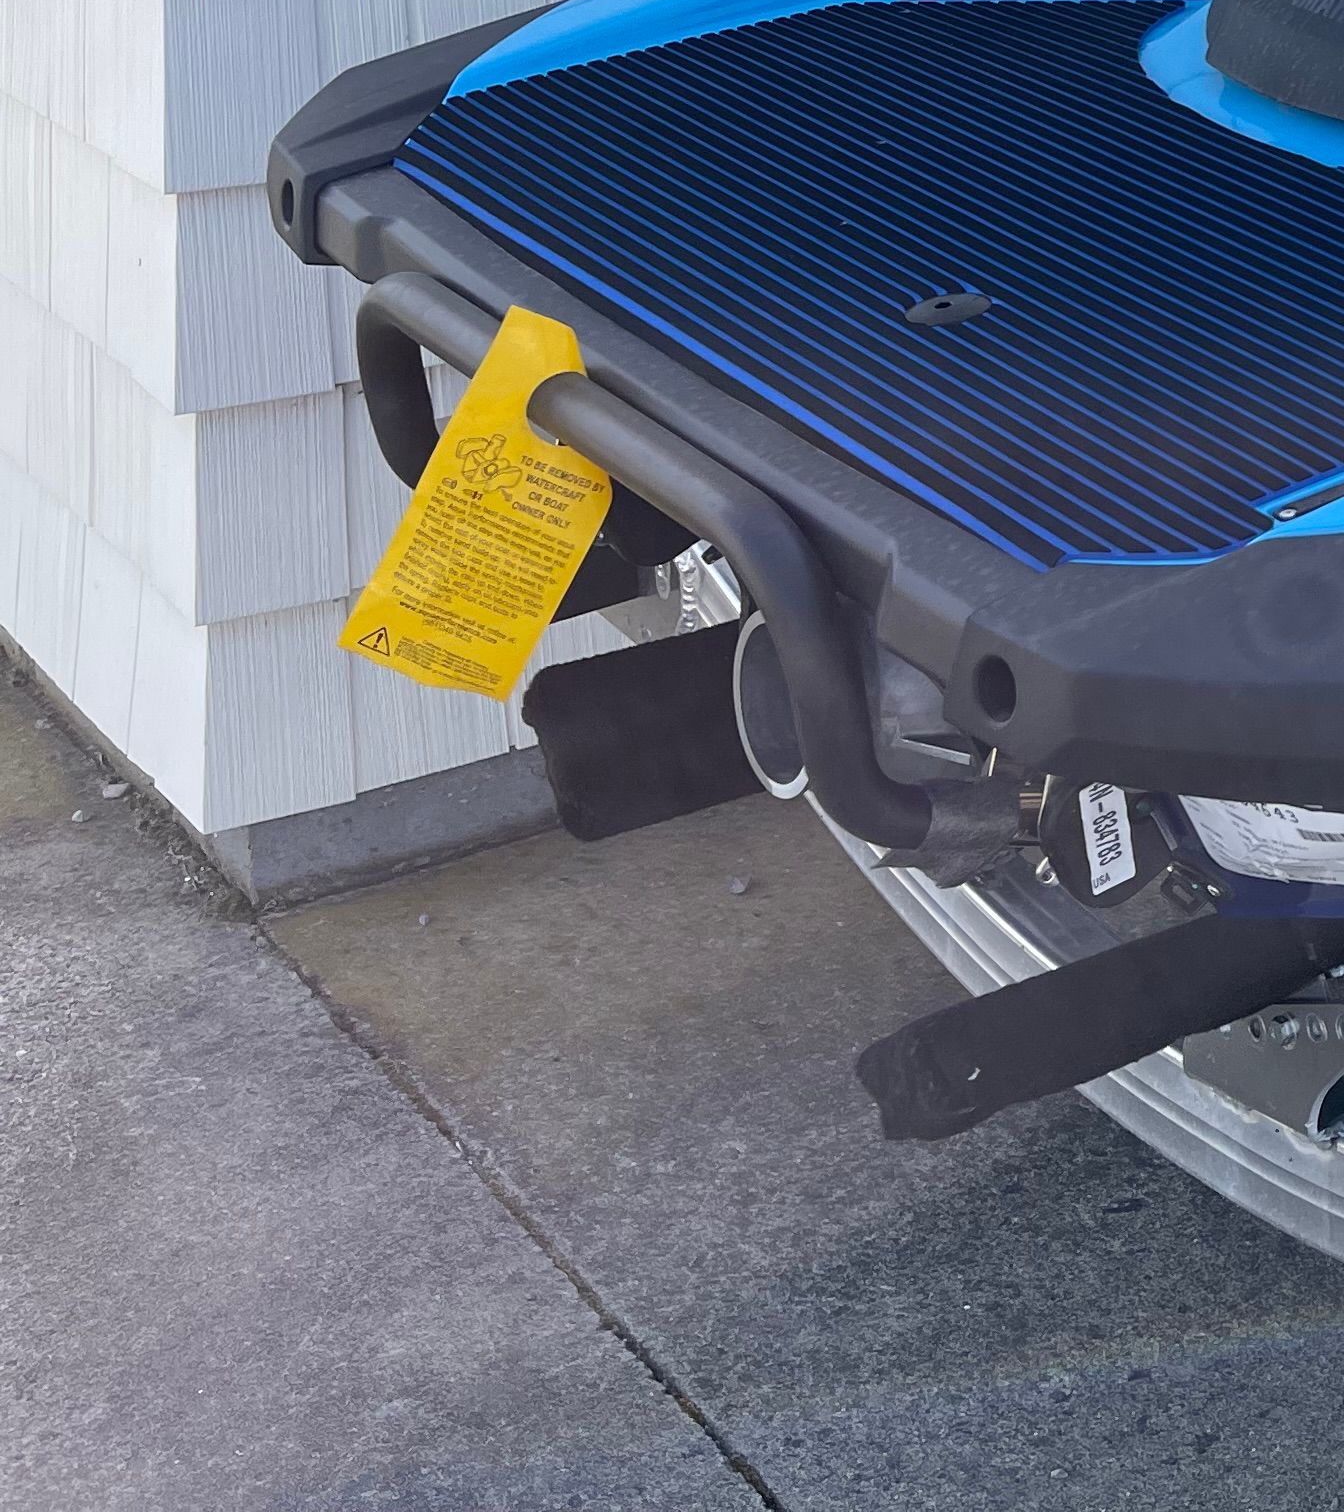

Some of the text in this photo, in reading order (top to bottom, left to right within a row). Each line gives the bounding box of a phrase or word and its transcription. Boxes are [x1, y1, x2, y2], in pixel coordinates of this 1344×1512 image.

[520, 455, 533, 467] TO
[547, 466, 592, 489] REMOVED
[526, 474, 586, 503] WATERCRAFT
[543, 497, 569, 513] BOAT
[546, 513, 572, 529] ONLY
[1092, 873, 1111, 889] USA
